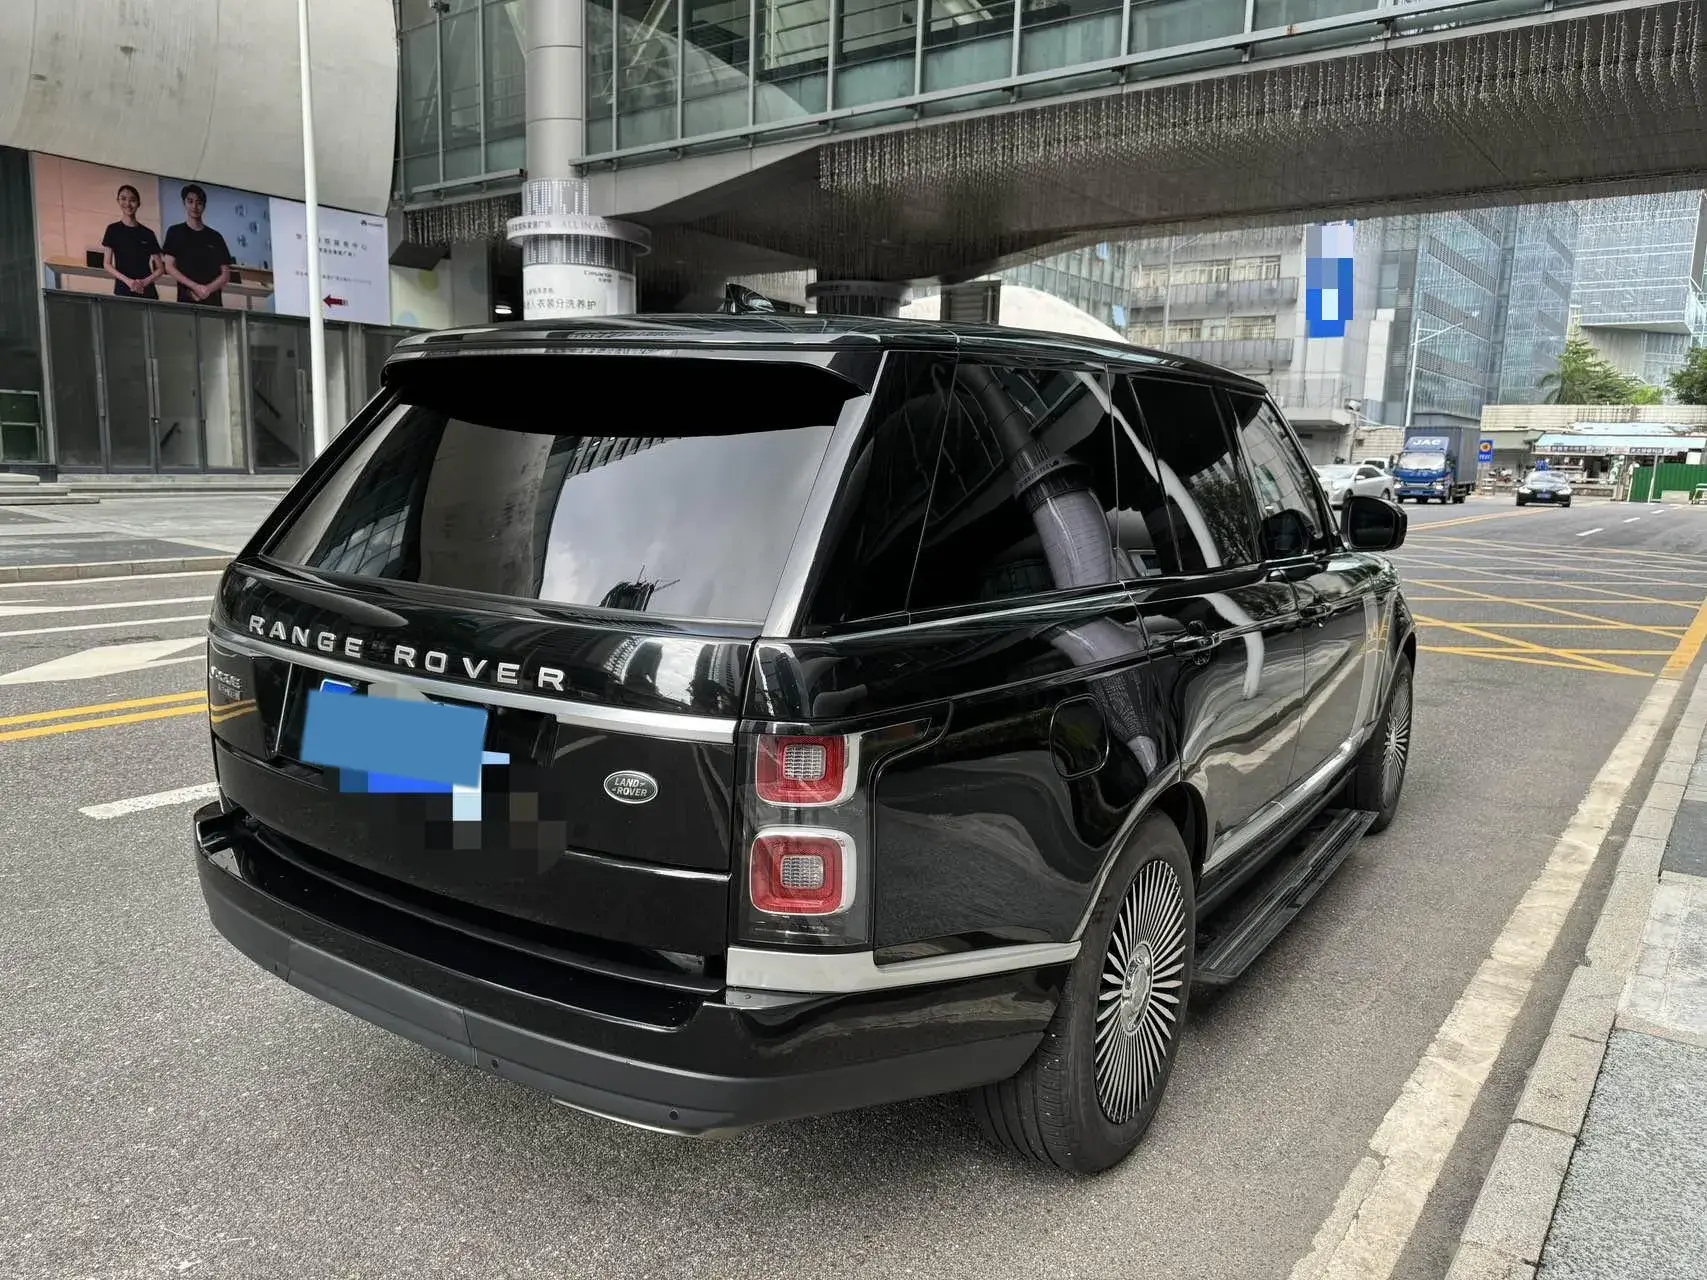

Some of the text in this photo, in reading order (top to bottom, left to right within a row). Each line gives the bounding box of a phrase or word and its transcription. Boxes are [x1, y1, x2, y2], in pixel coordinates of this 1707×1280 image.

[249, 615, 566, 691] RANGE ROVER
[614, 777, 640, 788] LAND
[616, 786, 648, 797] ROVER
